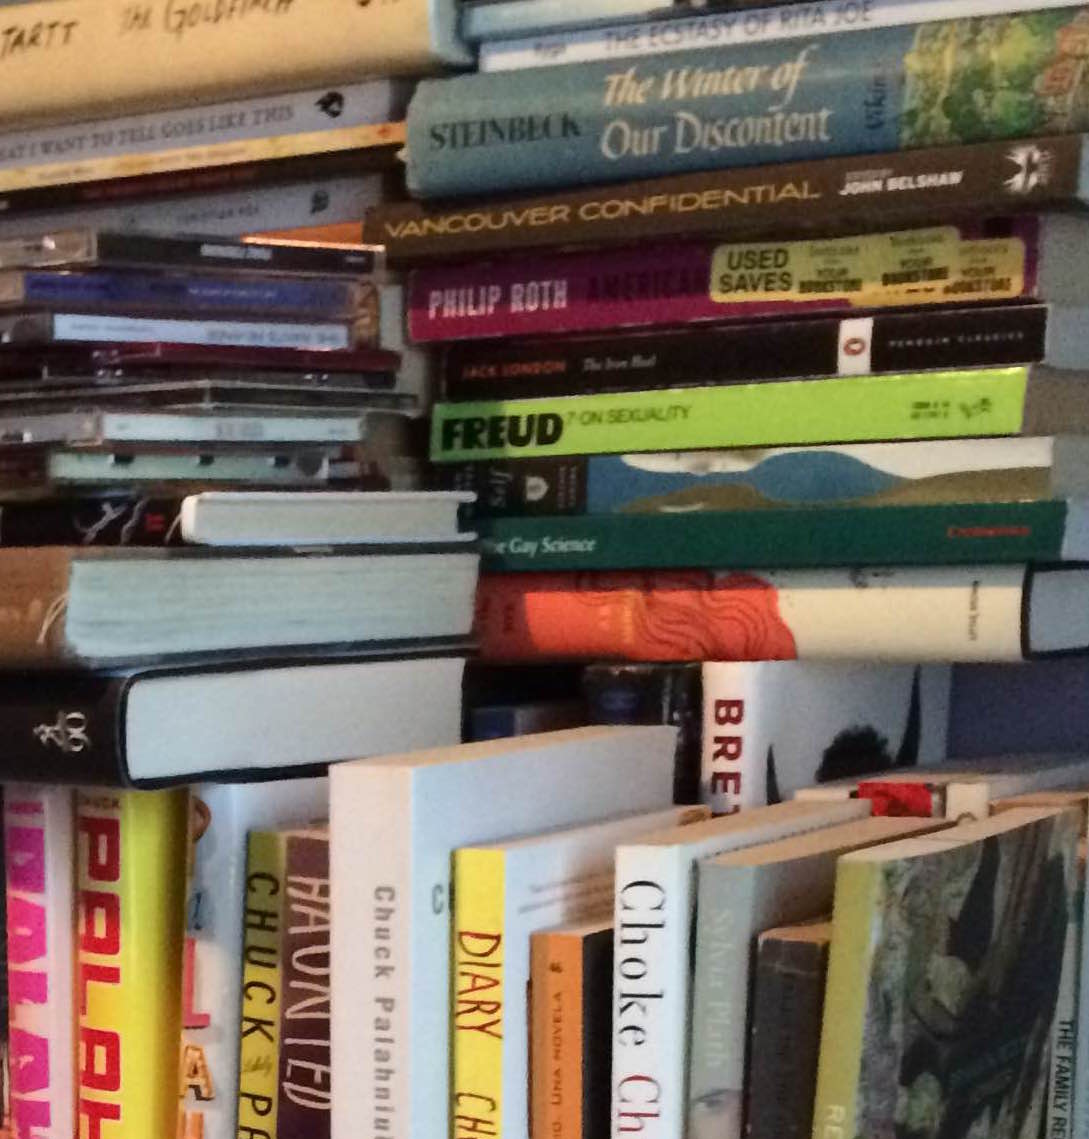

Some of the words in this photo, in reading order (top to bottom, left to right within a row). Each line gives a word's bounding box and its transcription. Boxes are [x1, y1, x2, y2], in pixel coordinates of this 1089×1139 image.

[0, 21, 78, 60] TARTT
[604, 31, 640, 52] THE
[649, 20, 726, 47] ECSTASY
[741, 14, 770, 36] OF
[778, 7, 826, 31] RITA
[836, 1, 874, 25] JOE
[604, 66, 652, 107] The
[662, 62, 763, 101] Winter
[769, 43, 812, 110] of
[38, 136, 88, 159] WANT
[91, 131, 114, 151] TO
[118, 126, 157, 147] TELL
[161, 118, 208, 139] GOES
[209, 112, 248, 135] LIKE
[250, 105, 295, 127] THIS
[430, 111, 582, 153] STEINBECK
[601, 118, 661, 161] Our
[675, 101, 831, 155] Discontent
[838, 176, 883, 197] JOHN
[886, 169, 966, 192] BELSHAW
[384, 205, 569, 239] VANCOUVER
[579, 182, 821, 223] CONFIDENTIAL
[718, 270, 794, 296] SAVES
[727, 249, 790, 272] USED
[428, 284, 503, 320] PHILIP
[509, 280, 569, 314] ROTH
[889, 336, 951, 350] PENGUIN
[958, 330, 1026, 345] CLASSICS
[441, 412, 565, 453] FREUD
[580, 408, 603, 427] ON
[608, 402, 694, 425] SEXUALITY
[509, 538, 539, 558] Gay
[541, 536, 597, 553] Science
[243, 869, 280, 1042] CHUCK
[371, 884, 397, 978] Chuck
[709, 908, 735, 990] Sylvia
[455, 931, 503, 1040] DIARY
[617, 879, 667, 1047] Choke
[283, 873, 333, 1112] HAUNTED
[550, 991, 565, 1062] NOVELA
[704, 1000, 731, 1069] Plath
[1056, 1018, 1077, 1052] THE
[550, 1067, 564, 1107] UNA
[1052, 1055, 1074, 1113] FAMILY
